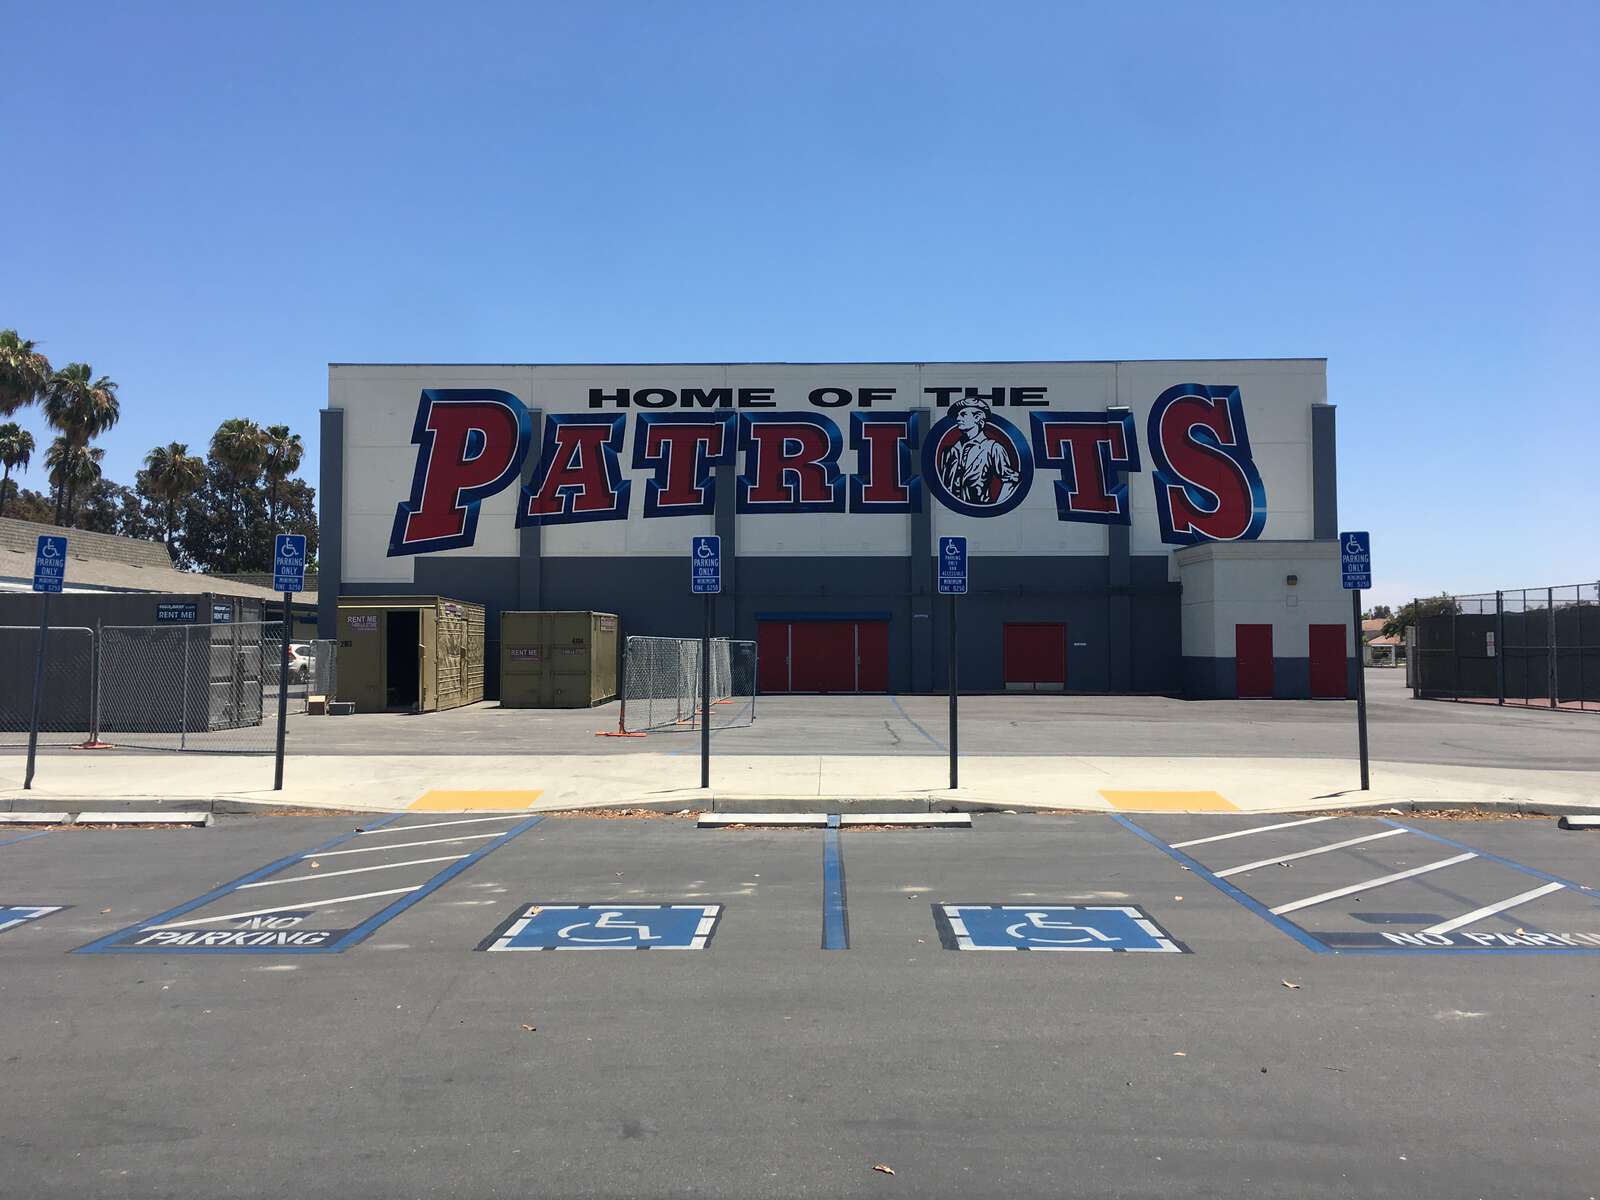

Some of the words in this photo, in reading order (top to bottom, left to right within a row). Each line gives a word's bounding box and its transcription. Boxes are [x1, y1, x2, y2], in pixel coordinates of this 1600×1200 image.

[588, 388, 776, 408] HOME
[808, 387, 897, 408] OF
[924, 387, 1050, 408] THE
[387, 383, 1267, 558] PATRIOTS
[37, 558, 64, 568] PARKING
[277, 557, 303, 567] PARKING
[1342, 554, 1369, 563] PARKING
[694, 559, 719, 568] PARKING
[1347, 563, 1364, 572] ONLY
[42, 567, 58, 576] ONLY
[281, 566, 298, 575] ONLY
[698, 567, 714, 576] ONLY
[158, 611, 178, 619] RENT
[180, 611, 195, 620] ME!
[234, 916, 304, 930] NO
[134, 931, 332, 946] PARKING
[1379, 931, 1455, 946] NO
